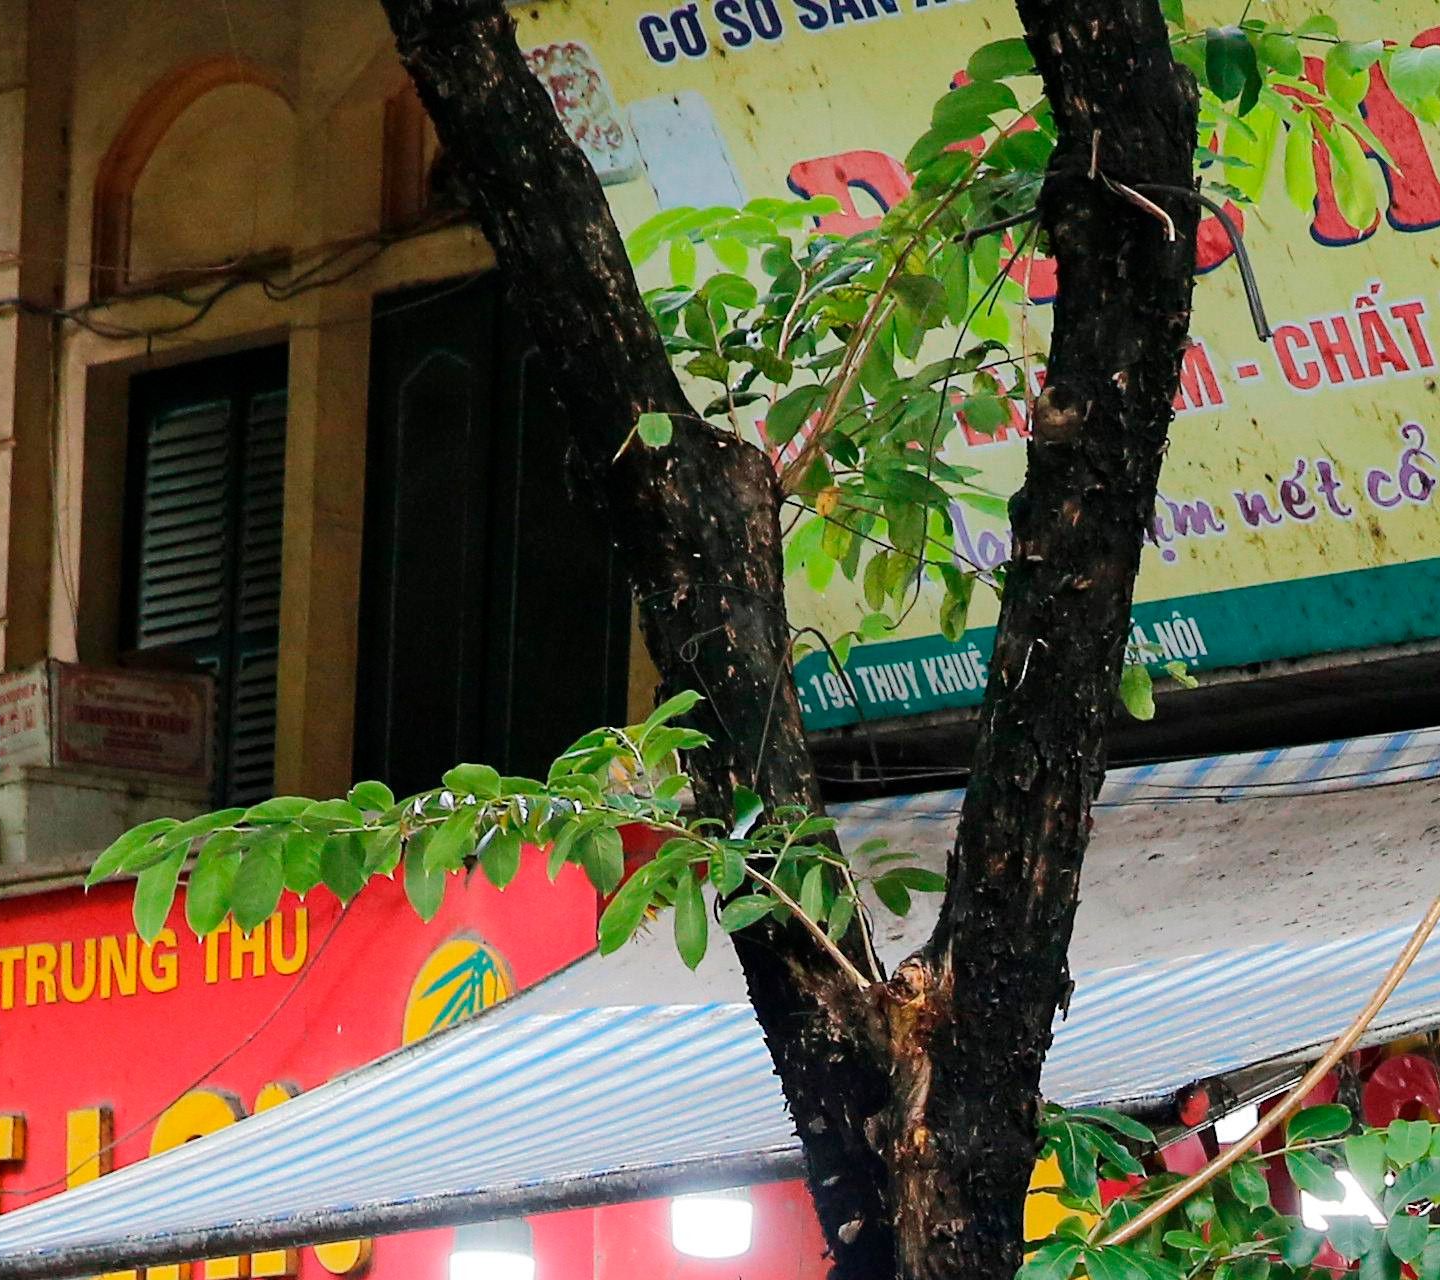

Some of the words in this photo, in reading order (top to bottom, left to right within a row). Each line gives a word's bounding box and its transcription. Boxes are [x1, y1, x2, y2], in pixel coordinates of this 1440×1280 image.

[639, 4, 708, 63] CƠ
[1273, 284, 1433, 391] CHẤT
[1241, 458, 1354, 530] nét
[1366, 424, 1440, 507] cổ
[856, 658, 920, 710] THỤY
[924, 643, 989, 696] KHUÊ
[1162, 610, 1209, 666] NỘI
[197, 907, 310, 984] THU
